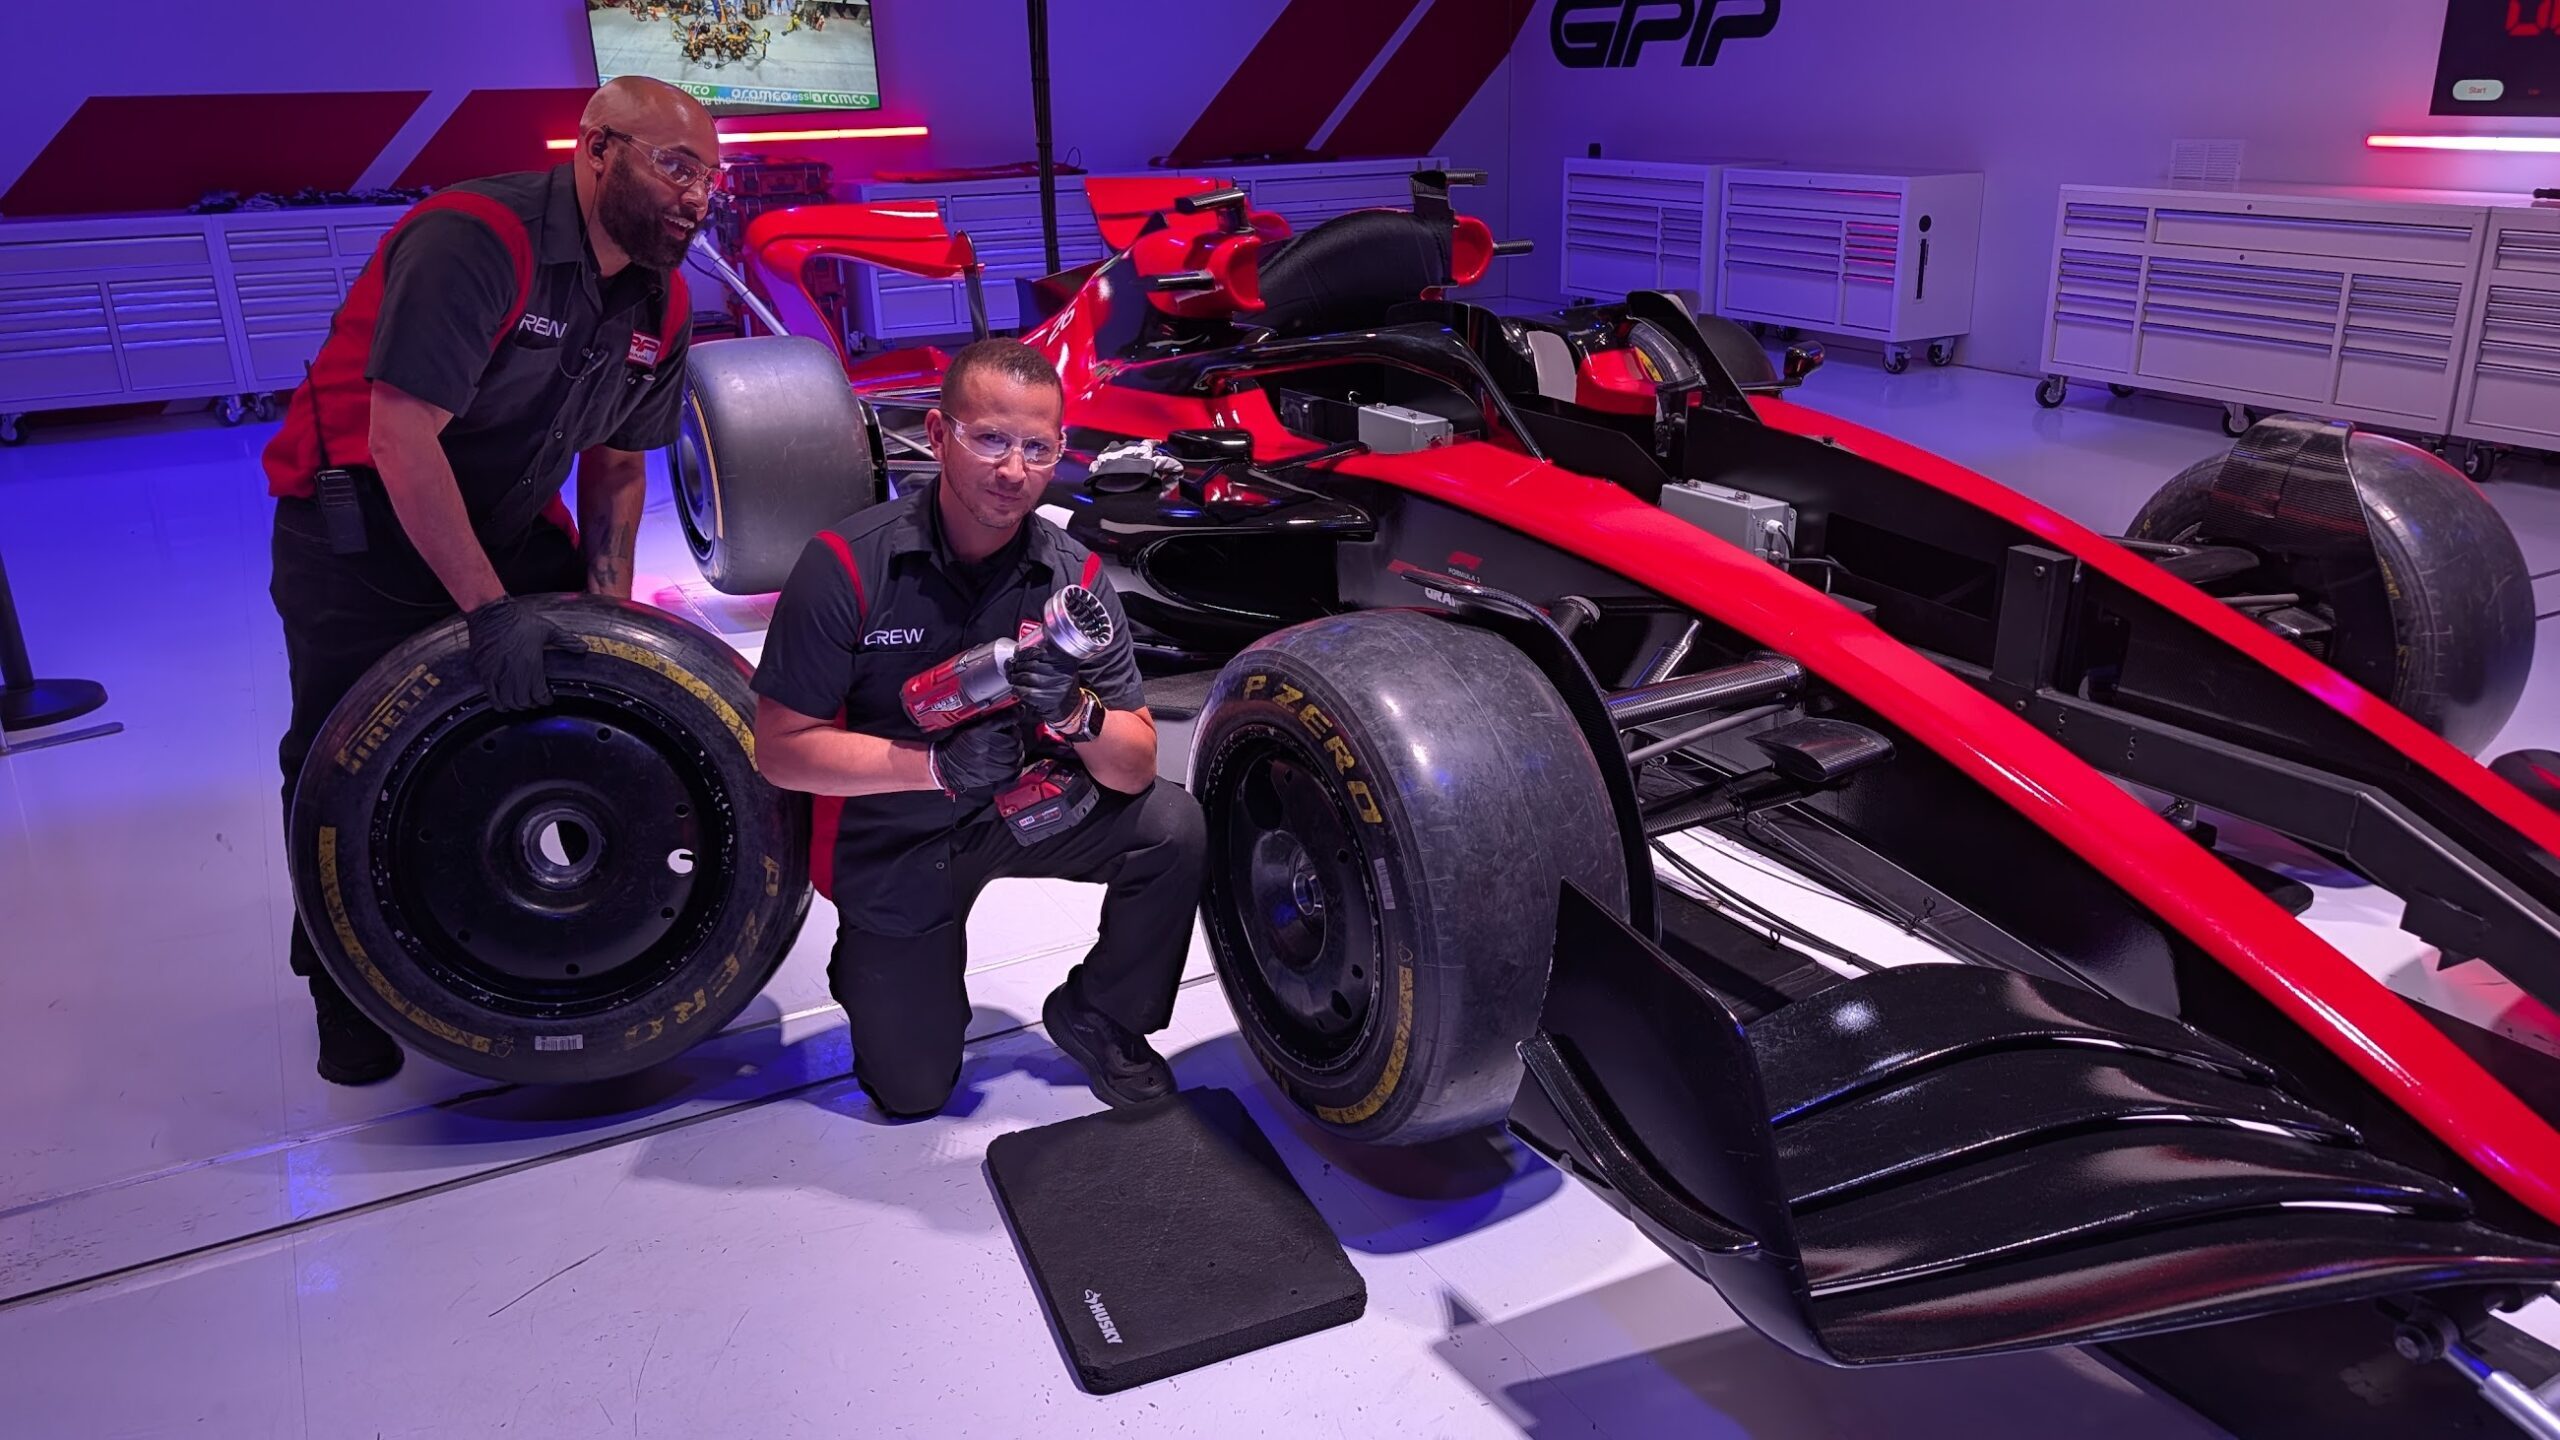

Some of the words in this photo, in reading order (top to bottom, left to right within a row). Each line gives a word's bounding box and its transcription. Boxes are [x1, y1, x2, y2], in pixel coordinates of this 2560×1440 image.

[1550, 0, 1781, 68] GPP
[812, 93, 870, 106] aramco
[518, 313, 568, 339] REW
[1447, 567, 1476, 582] FORMULA
[864, 627, 925, 646] CREW
[335, 663, 441, 776] PIRELLI
[1243, 675, 1268, 699] P
[1270, 682, 1384, 825] ZERO
[1089, 1302, 1124, 1344] HUSKY
